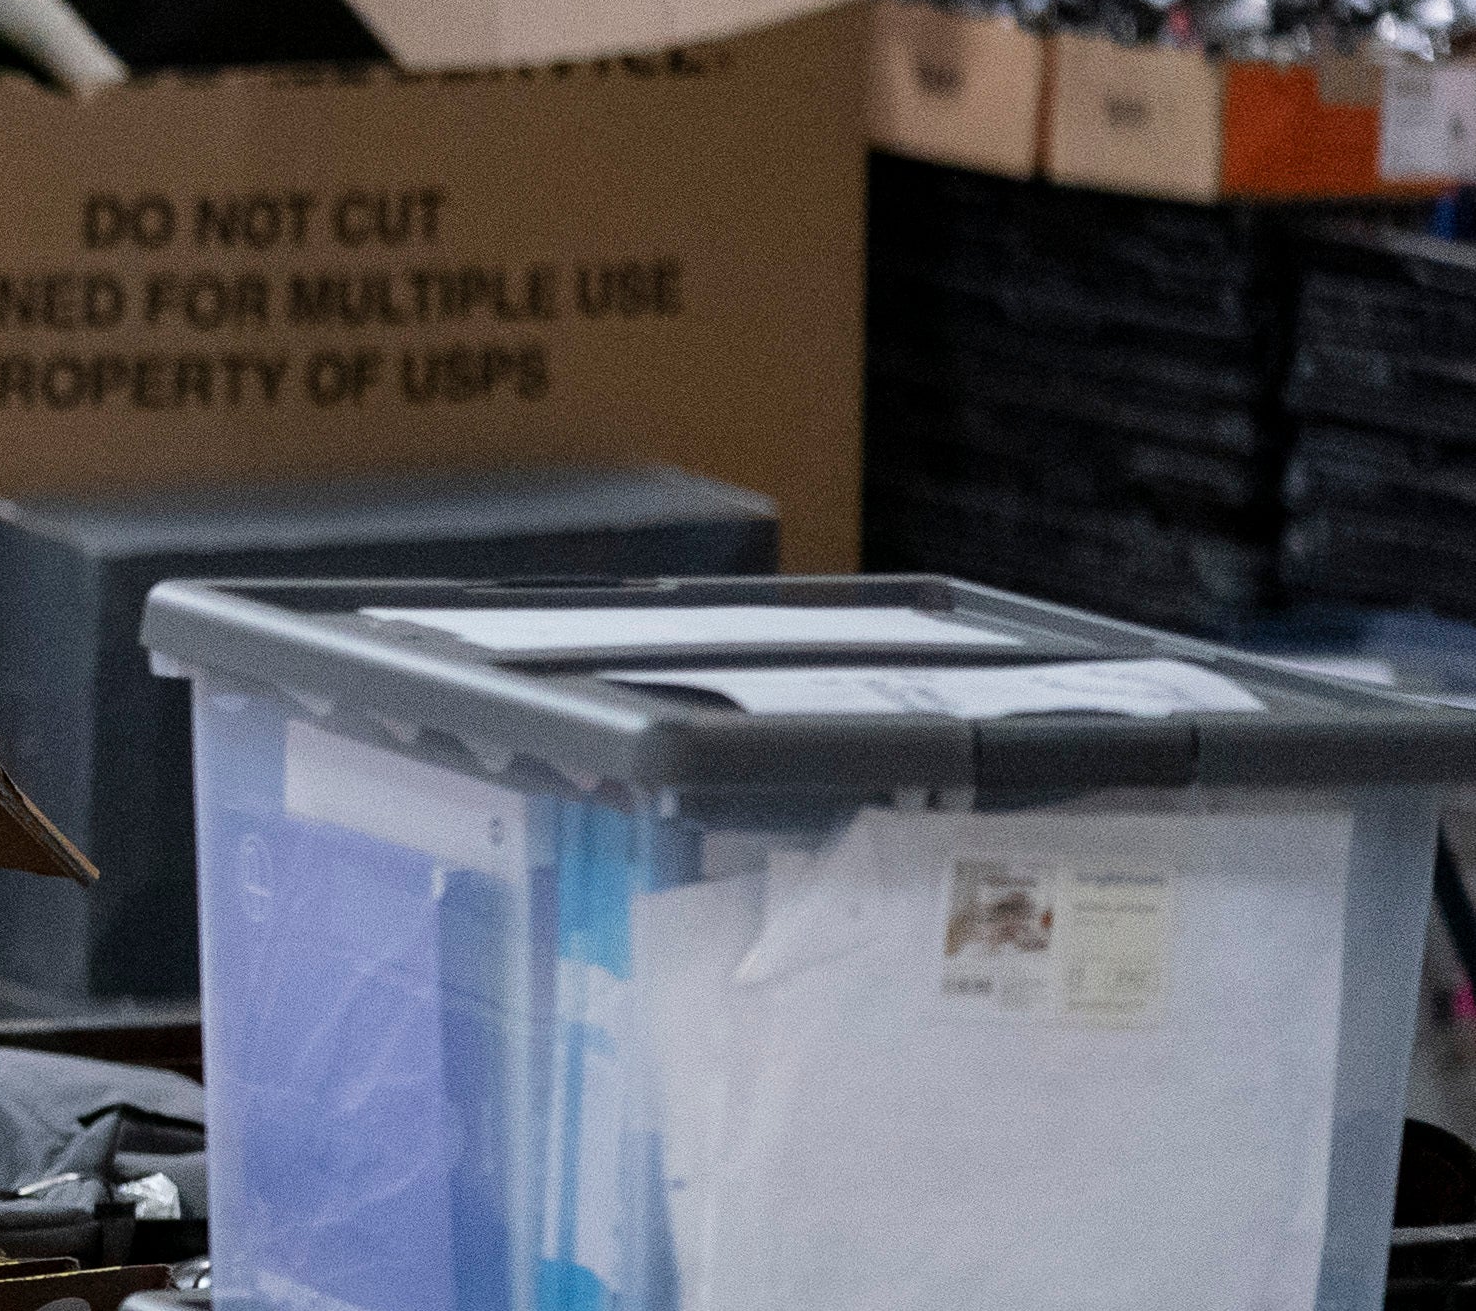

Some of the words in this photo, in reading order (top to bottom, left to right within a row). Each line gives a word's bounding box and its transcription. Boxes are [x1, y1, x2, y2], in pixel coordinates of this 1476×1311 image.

[82, 192, 172, 250] DO
[194, 188, 314, 248] NOT
[334, 186, 445, 247] CUT
[145, 268, 267, 328] FOR
[288, 262, 557, 325] MULTIPLE
[576, 256, 682, 319] USE
[305, 345, 383, 406] OF
[400, 341, 549, 404] USPS
